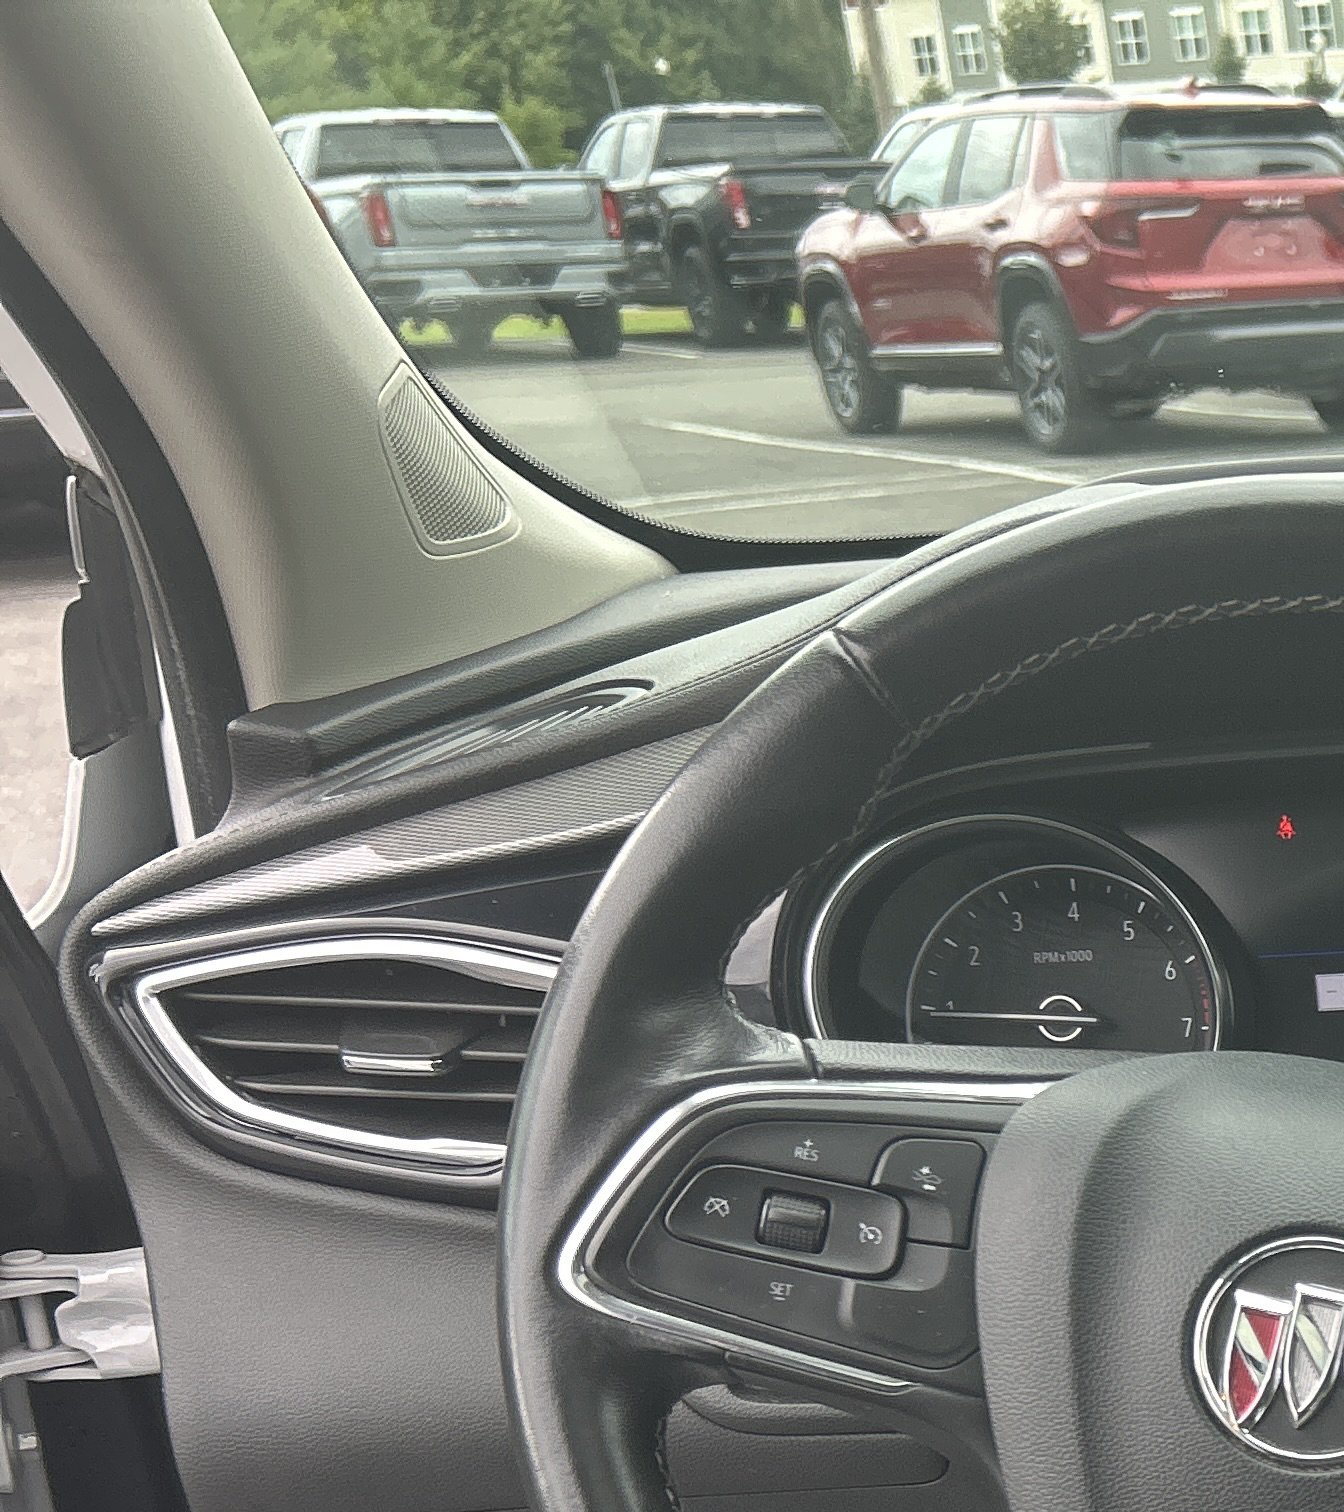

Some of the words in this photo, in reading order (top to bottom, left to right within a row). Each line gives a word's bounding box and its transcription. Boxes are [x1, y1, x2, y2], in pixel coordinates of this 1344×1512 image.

[1011, 912, 1023, 931] 3
[1068, 902, 1080, 922] 4
[1123, 921, 1135, 941] 5
[969, 946, 980, 966] 2
[1164, 961, 1177, 980] 6
[1181, 1017, 1193, 1038] 7
[794, 1146, 820, 1162] RES
[769, 1282, 794, 1297] SET
